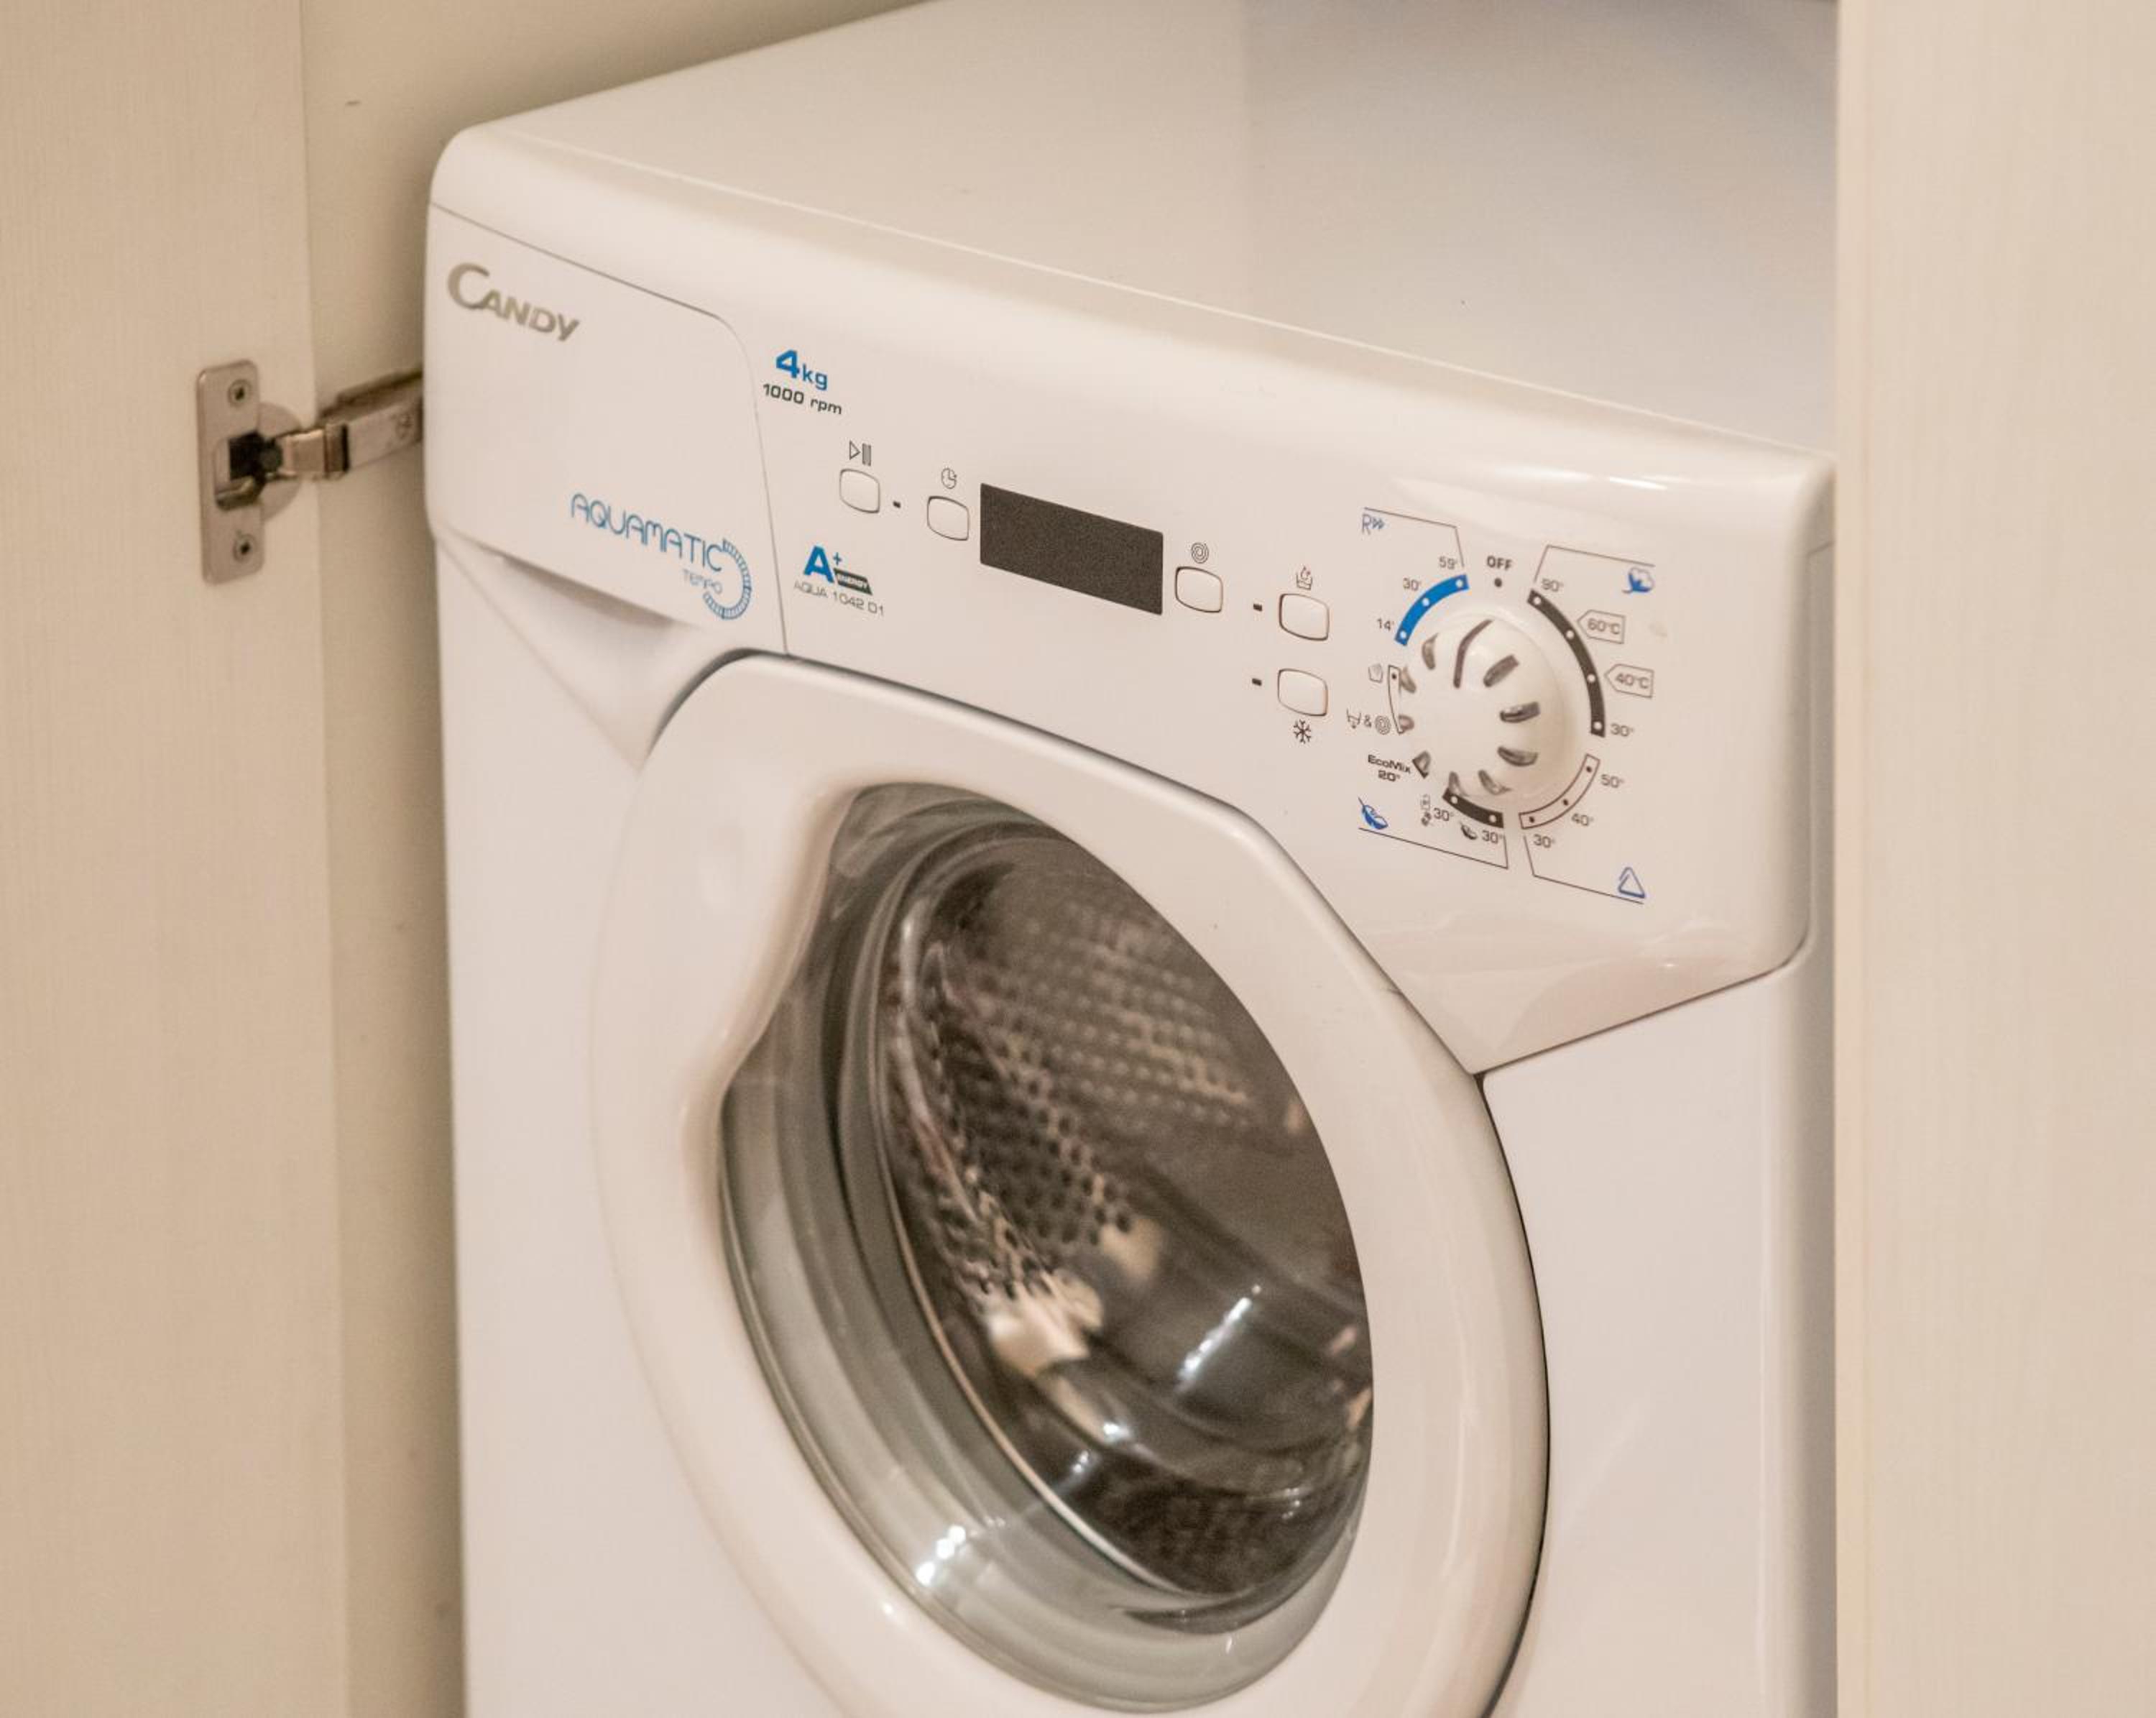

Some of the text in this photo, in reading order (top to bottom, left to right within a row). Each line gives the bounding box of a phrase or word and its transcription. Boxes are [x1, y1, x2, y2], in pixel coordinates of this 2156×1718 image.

[447, 263, 580, 342] CANDY
[763, 382, 842, 415] 1000 rpm
[571, 493, 722, 572] AQUAMATIC
[1486, 555, 1513, 572] OFF
[793, 579, 828, 598] AQUA
[832, 591, 864, 610] 1042
[1368, 754, 1411, 774] EcoMix
